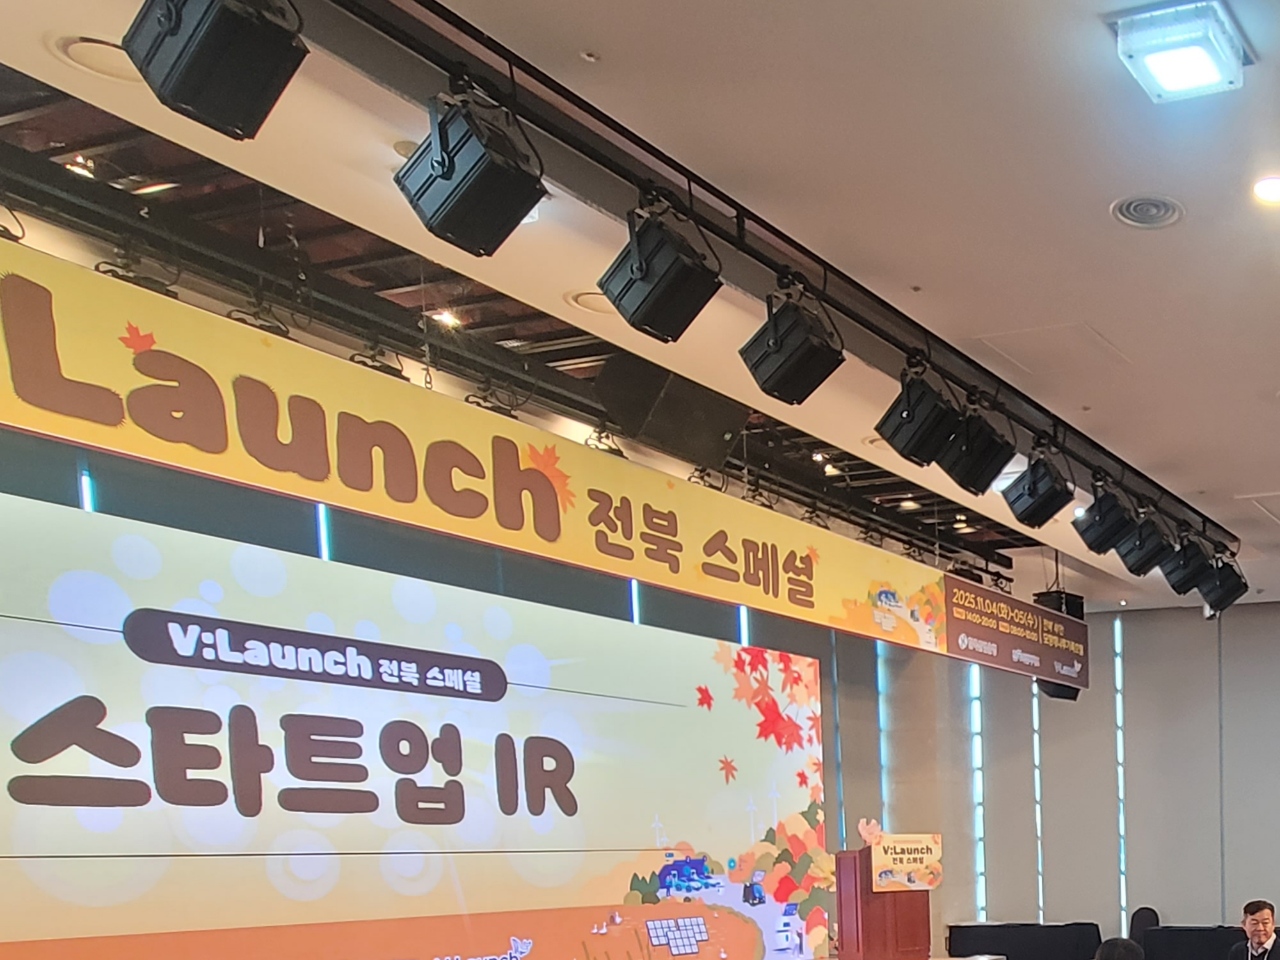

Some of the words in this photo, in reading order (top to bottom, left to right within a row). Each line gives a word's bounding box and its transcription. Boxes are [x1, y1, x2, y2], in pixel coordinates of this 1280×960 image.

[1, 272, 562, 543] Launch
[587, 488, 683, 574] 전북
[701, 530, 815, 609] 스페셜
[167, 622, 373, 680] V:Launch
[378, 658, 420, 687] 전북
[425, 666, 483, 694] 스페셜
[6, 695, 466, 825] 스타트업
[495, 733, 579, 817] IR
[882, 845, 933, 855] V:Launch
